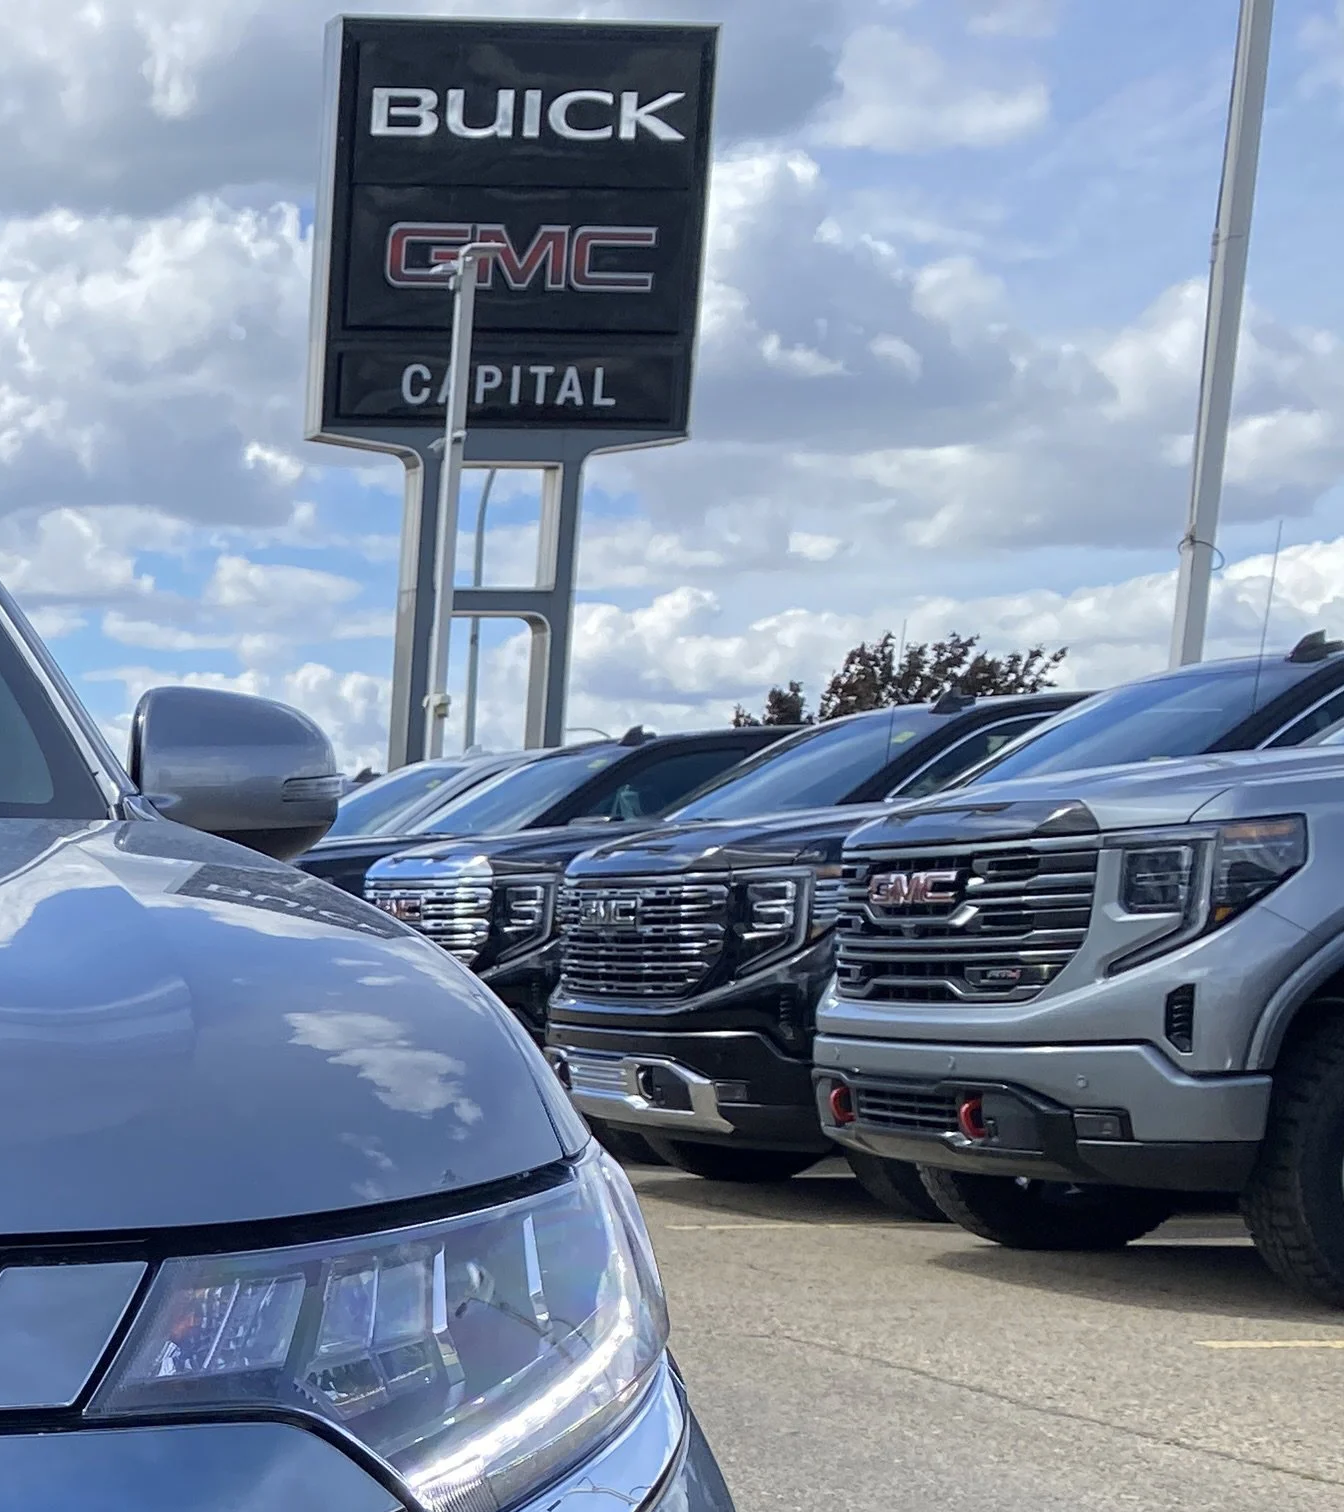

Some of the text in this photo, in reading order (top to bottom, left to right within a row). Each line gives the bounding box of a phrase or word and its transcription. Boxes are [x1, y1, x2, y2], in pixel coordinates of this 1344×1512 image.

[369, 86, 686, 141] BUICK
[385, 221, 659, 292] GMC
[869, 870, 958, 905] GMC
